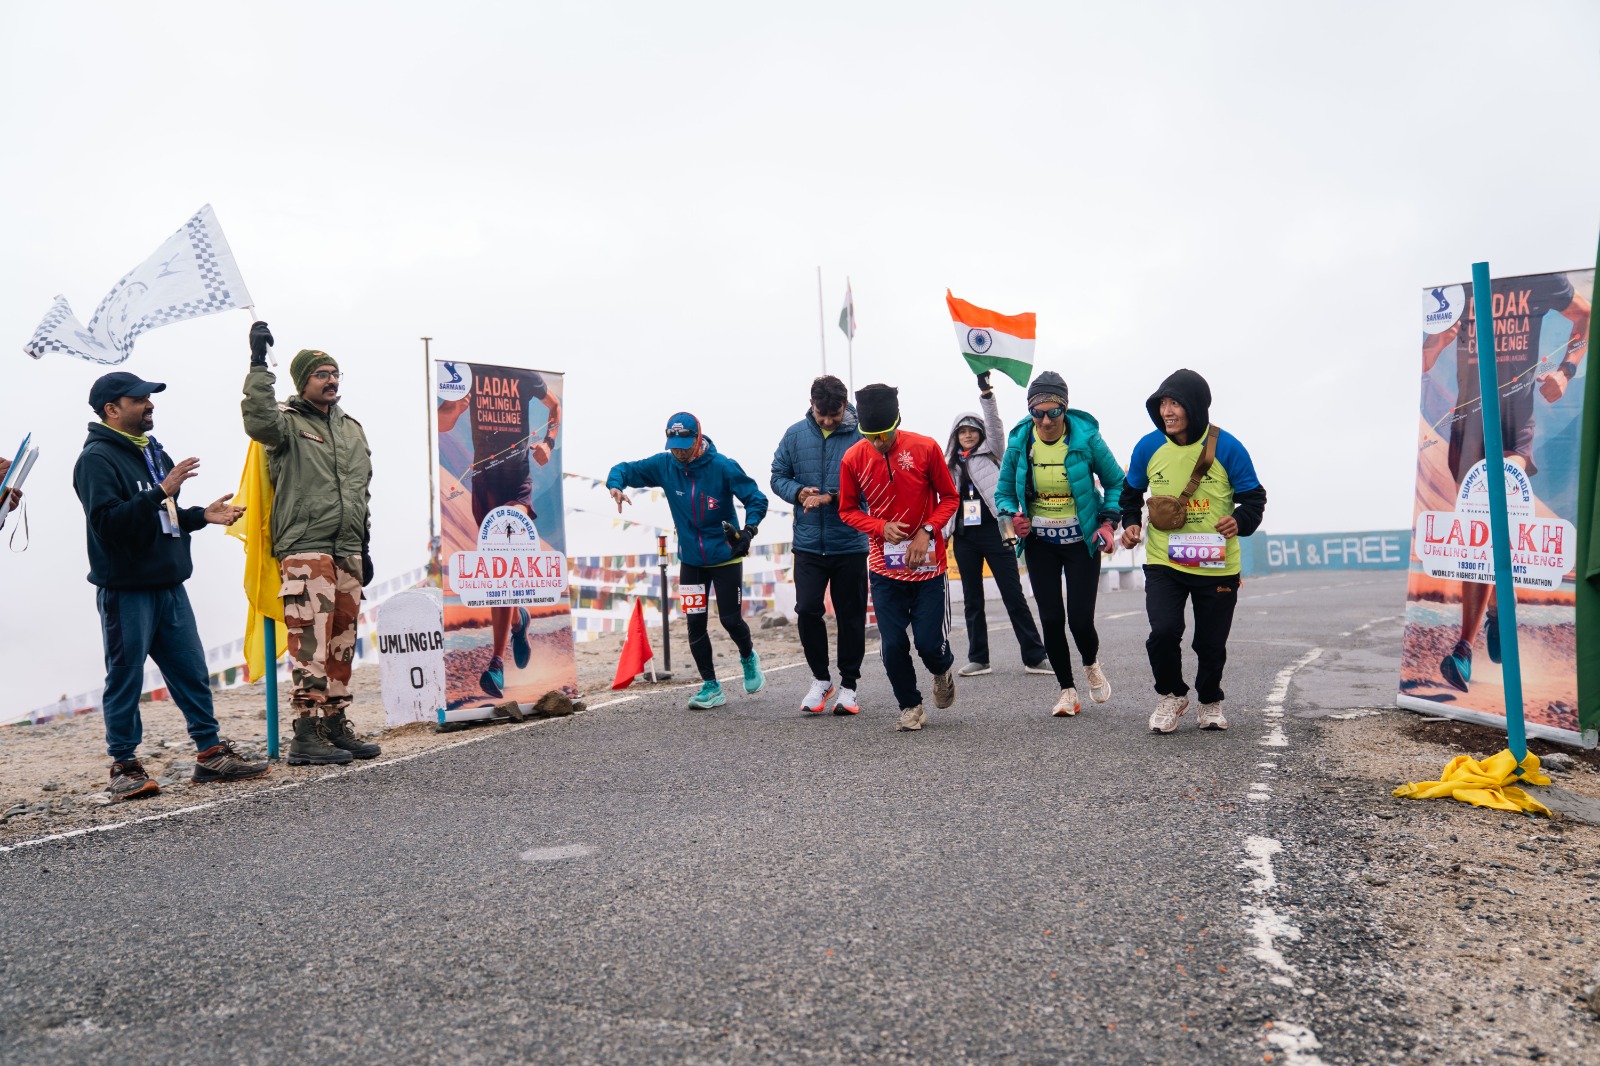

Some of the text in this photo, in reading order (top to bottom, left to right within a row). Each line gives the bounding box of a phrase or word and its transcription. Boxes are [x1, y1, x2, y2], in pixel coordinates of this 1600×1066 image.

[1469, 290, 1532, 320] LDAK
[1426, 311, 1453, 322] SARMANG
[1468, 317, 1530, 337] UINGLA
[1468, 335, 1529, 353] CLENGE
[439, 383, 466, 391] SARMANG
[475, 375, 520, 398] LADAK
[476, 396, 521, 411] UMLINGLA
[477, 410, 521, 424] CHALLENGE
[1461, 468, 1480, 499] SUMMIT
[481, 514, 495, 540] SUMMIT
[507, 509, 535, 540] SURRENDER
[1036, 527, 1078, 538] 5001
[1425, 514, 1564, 555] LADKH
[1172, 546, 1221, 559] X002
[1322, 536, 1401, 565] FREE
[1423, 544, 1564, 568] UMLING LA ALLENGE
[458, 554, 562, 578] LADAKH
[1458, 561, 1476, 570] 19300
[1477, 563, 1485, 571] FT
[1513, 565, 1527, 574] MTS
[458, 579, 563, 589] UMLING LA CHALLENGE
[1431, 569, 1455, 578] WORLD'S
[1456, 571, 1477, 580] HIGHEST
[1522, 577, 1552, 587] MARATHON
